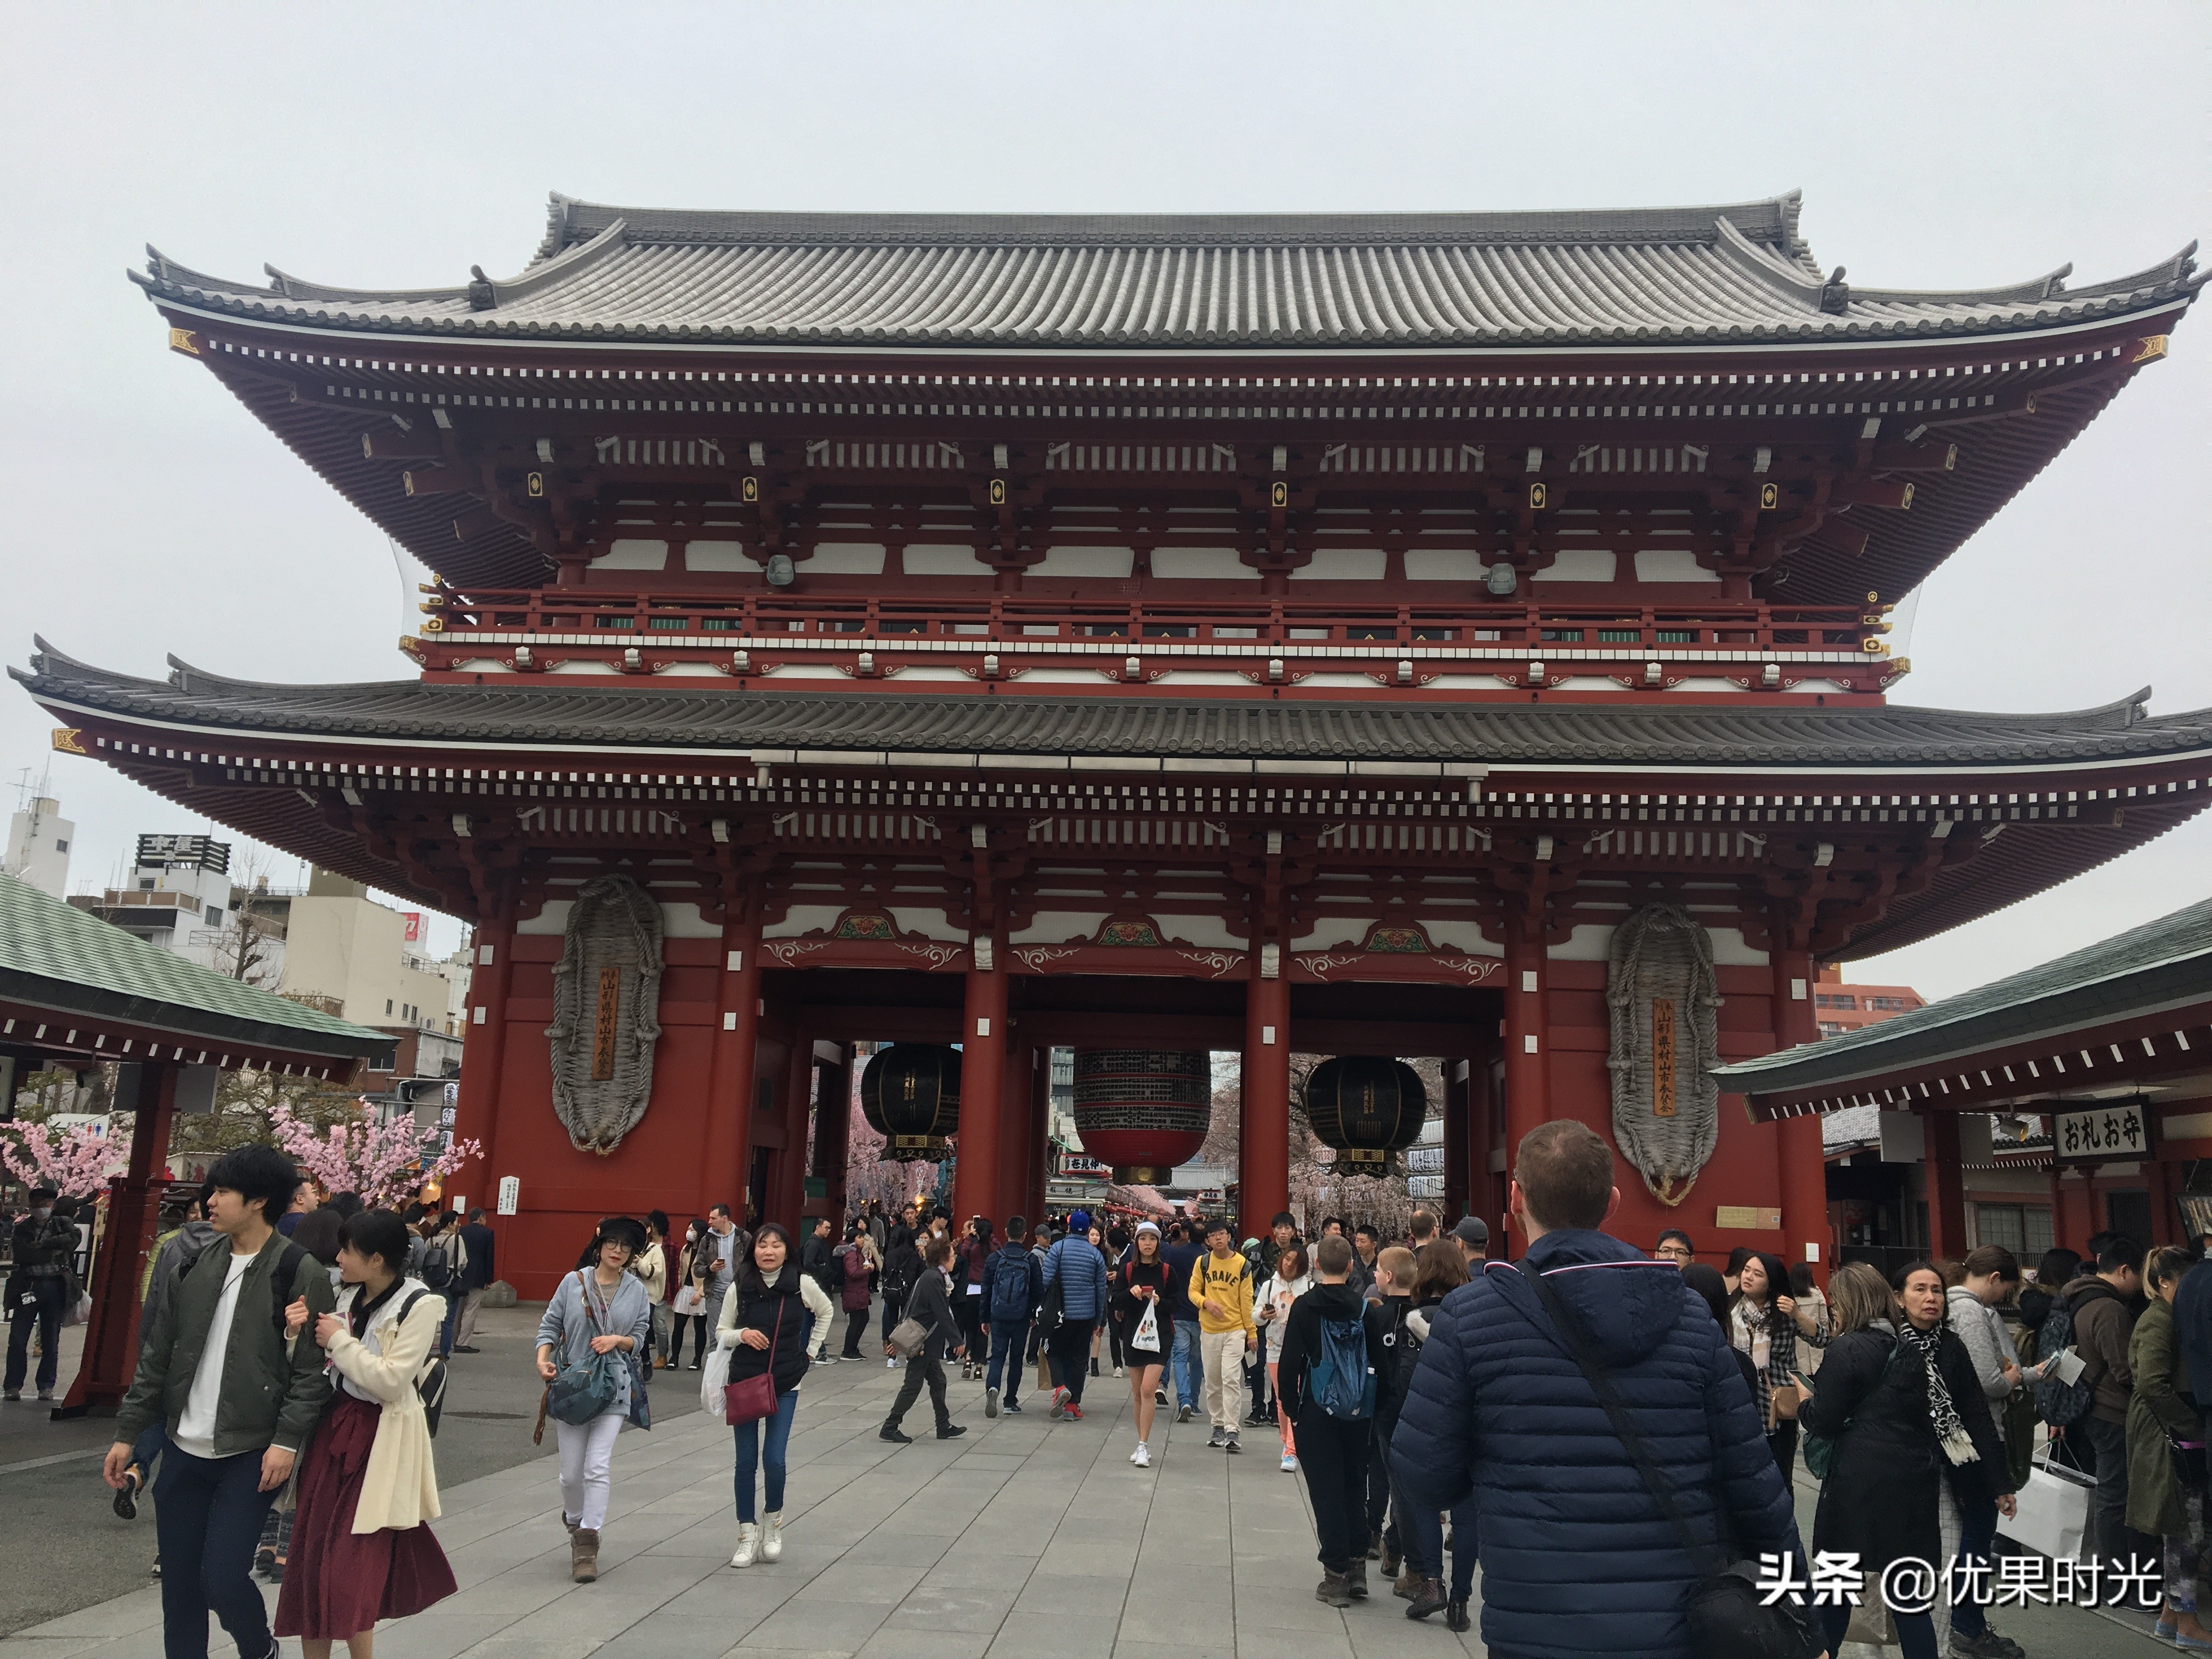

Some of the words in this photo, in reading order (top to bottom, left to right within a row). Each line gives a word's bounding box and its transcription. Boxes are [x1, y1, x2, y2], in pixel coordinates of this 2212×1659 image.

[2064, 1110, 2141, 1152] お札お守
[1205, 1270, 1239, 1287] BRAVE
